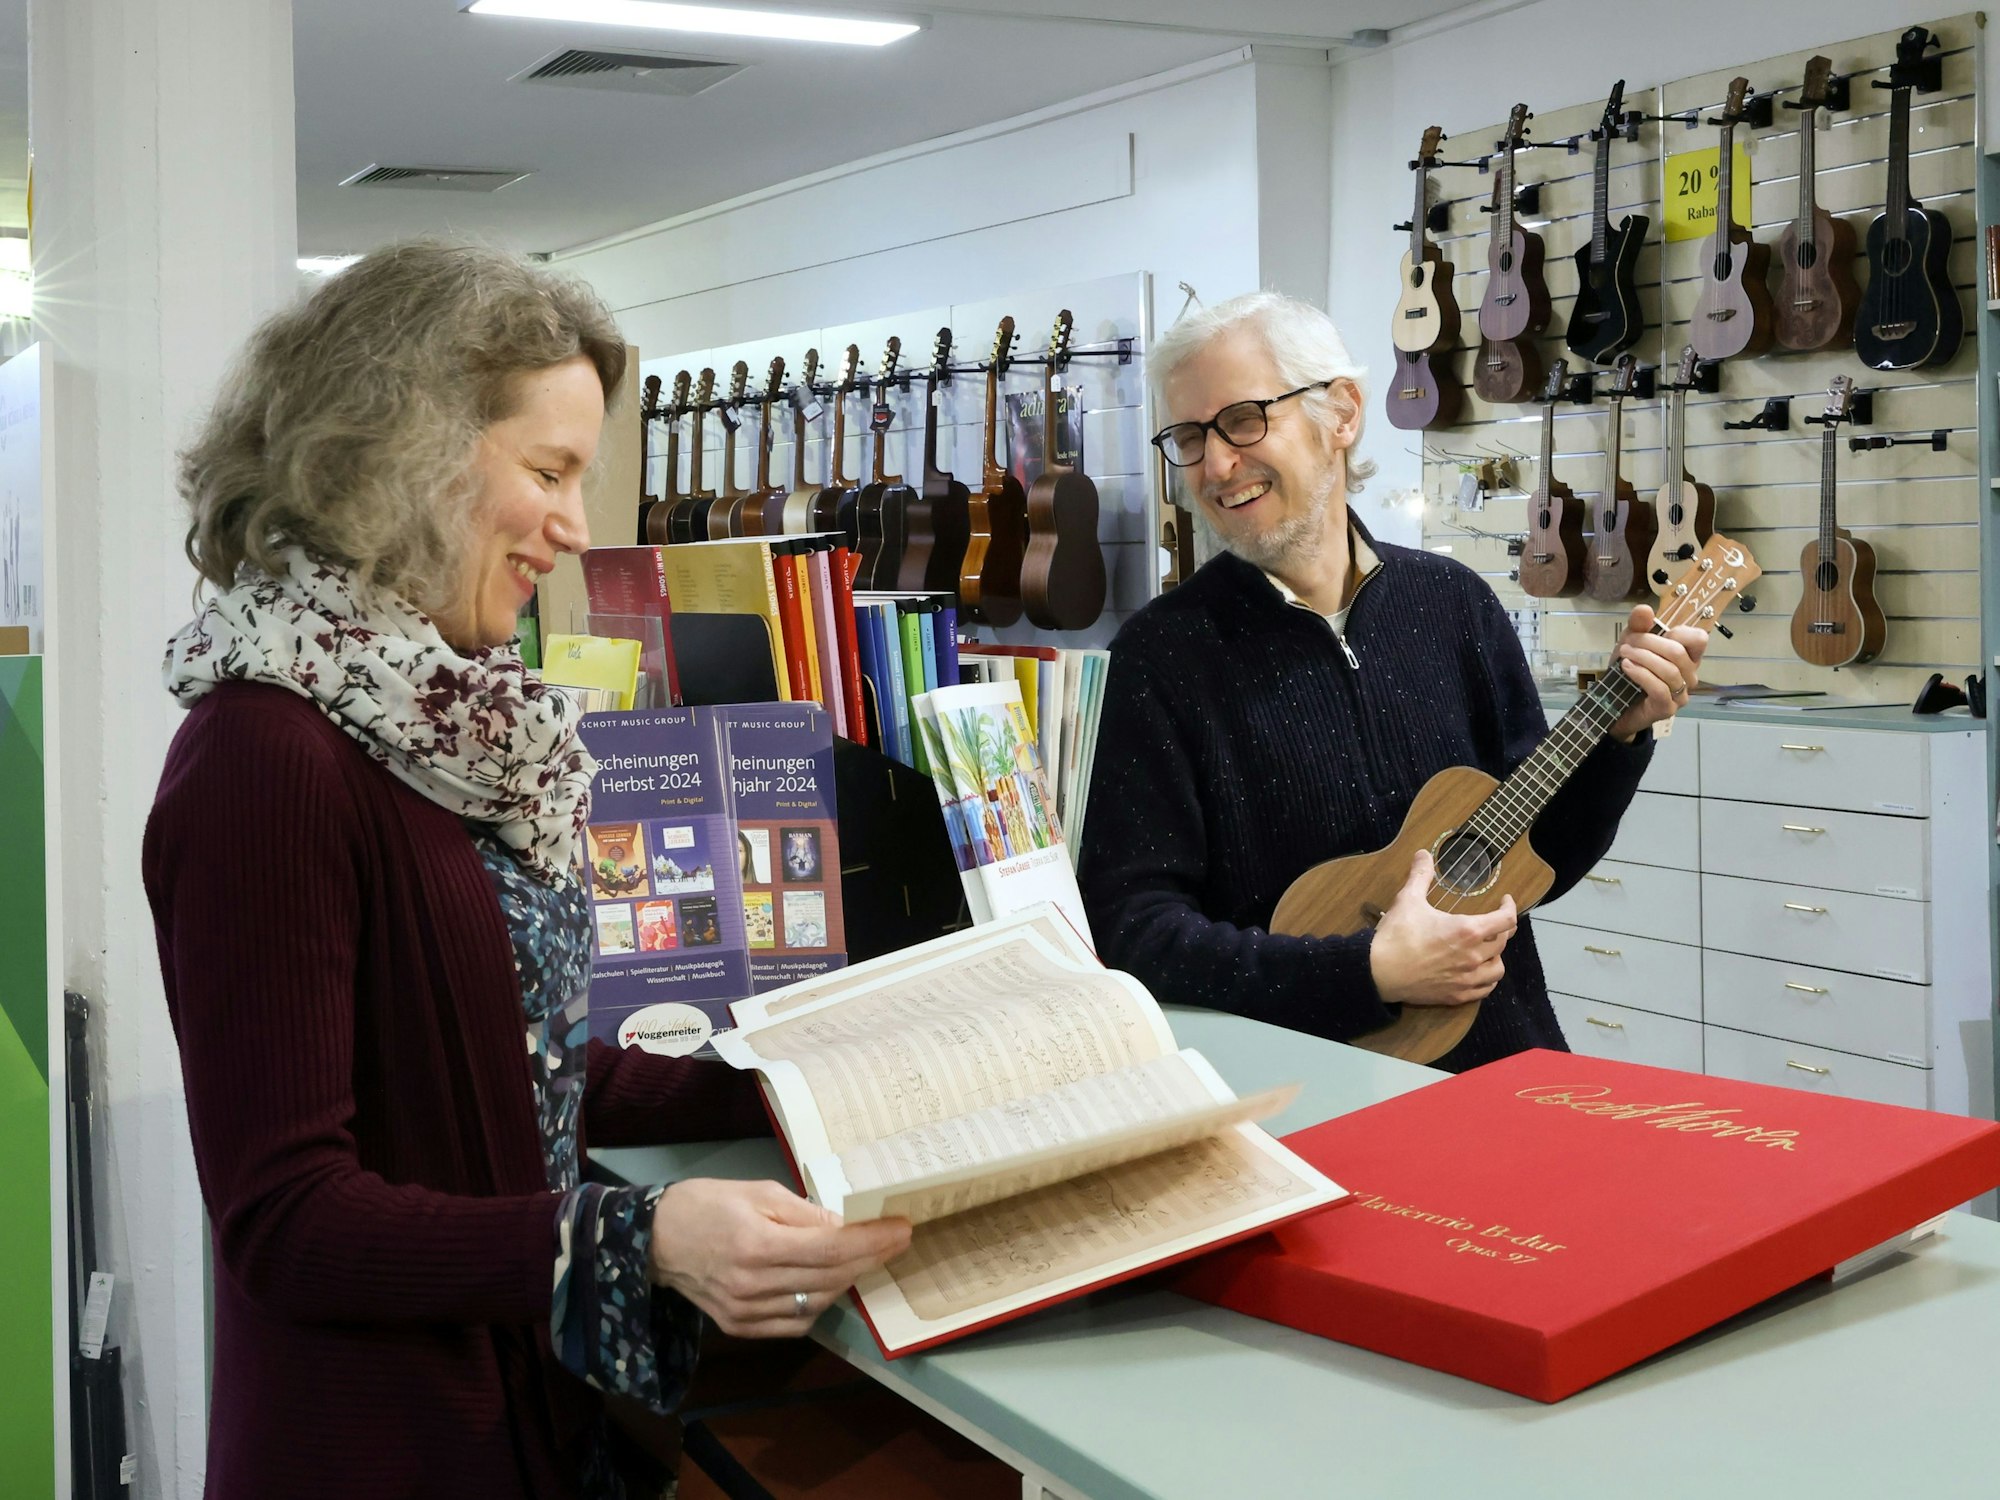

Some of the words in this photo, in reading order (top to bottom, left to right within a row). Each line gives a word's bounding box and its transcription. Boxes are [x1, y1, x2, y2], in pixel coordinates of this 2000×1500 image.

[1679, 168, 1702, 197] 20
[1687, 205, 1719, 221] Raba
[657, 562, 665, 574] HIT
[658, 575, 668, 598] SONGS
[768, 592, 779, 617] SONGS
[581, 720, 617, 729] SCHOTT
[620, 718, 651, 727] MUSIC
[654, 716, 687, 726] GROUP
[741, 721, 771, 729] MUSIC
[774, 721, 806, 729] GROUP
[596, 752, 699, 772] scheinungen
[731, 754, 815, 774] heinungen
[601, 775, 656, 793] Herbst
[659, 772, 702, 790] 2024
[732, 776, 772, 797] hjahr
[775, 776, 817, 793] 2024
[683, 796, 704, 806] Digital
[591, 970, 625, 979] talschulen
[630, 965, 669, 976] Spielliteratur
[675, 960, 724, 972] Musikpädagogik
[780, 962, 828, 971] Musikpädagogik
[646, 974, 687, 984] Wissenschaft
[692, 971, 726, 981] Musikbuch
[753, 973, 791, 981] Wissenschaft
[637, 1027, 702, 1041] Voggenreiter
[1479, 1224, 1568, 1253] B-dur
[1445, 1238, 1498, 1259] Opus
[1501, 1252, 1540, 1264] 97
